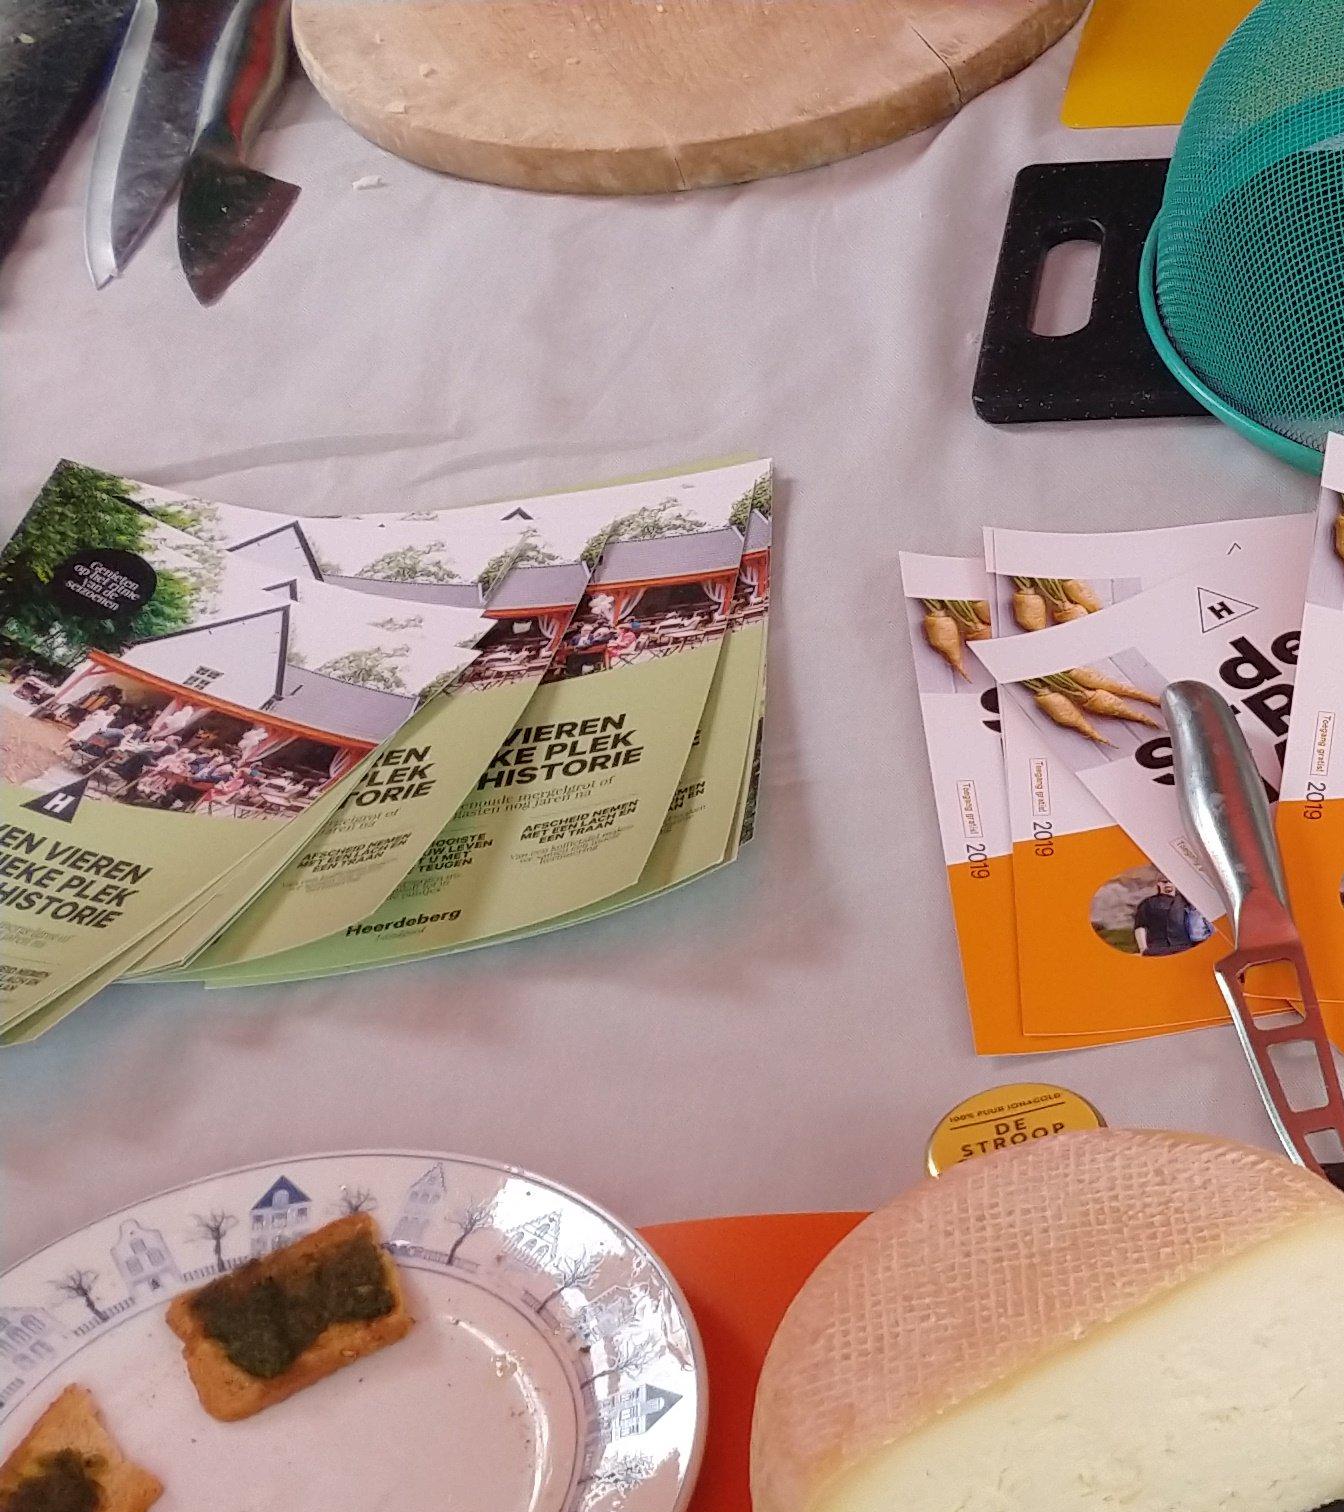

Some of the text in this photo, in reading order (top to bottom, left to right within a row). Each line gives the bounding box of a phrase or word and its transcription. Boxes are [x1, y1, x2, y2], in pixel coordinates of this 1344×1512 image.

[1209, 601, 1234, 620] H
[1219, 630, 1301, 689] de
[502, 713, 626, 747] VIEREN
[544, 730, 637, 762] PLEK
[477, 746, 644, 791] HISTORIE
[1303, 781, 1326, 820] 2019
[1033, 821, 1055, 857] 2019
[45, 841, 153, 885] VIEREN
[967, 843, 990, 880] 2019
[55, 875, 139, 907] PLEK
[345, 909, 462, 937] Heerdeberg
[961, 1122, 1065, 1158] STROOP
[995, 1117, 1027, 1136] DE
